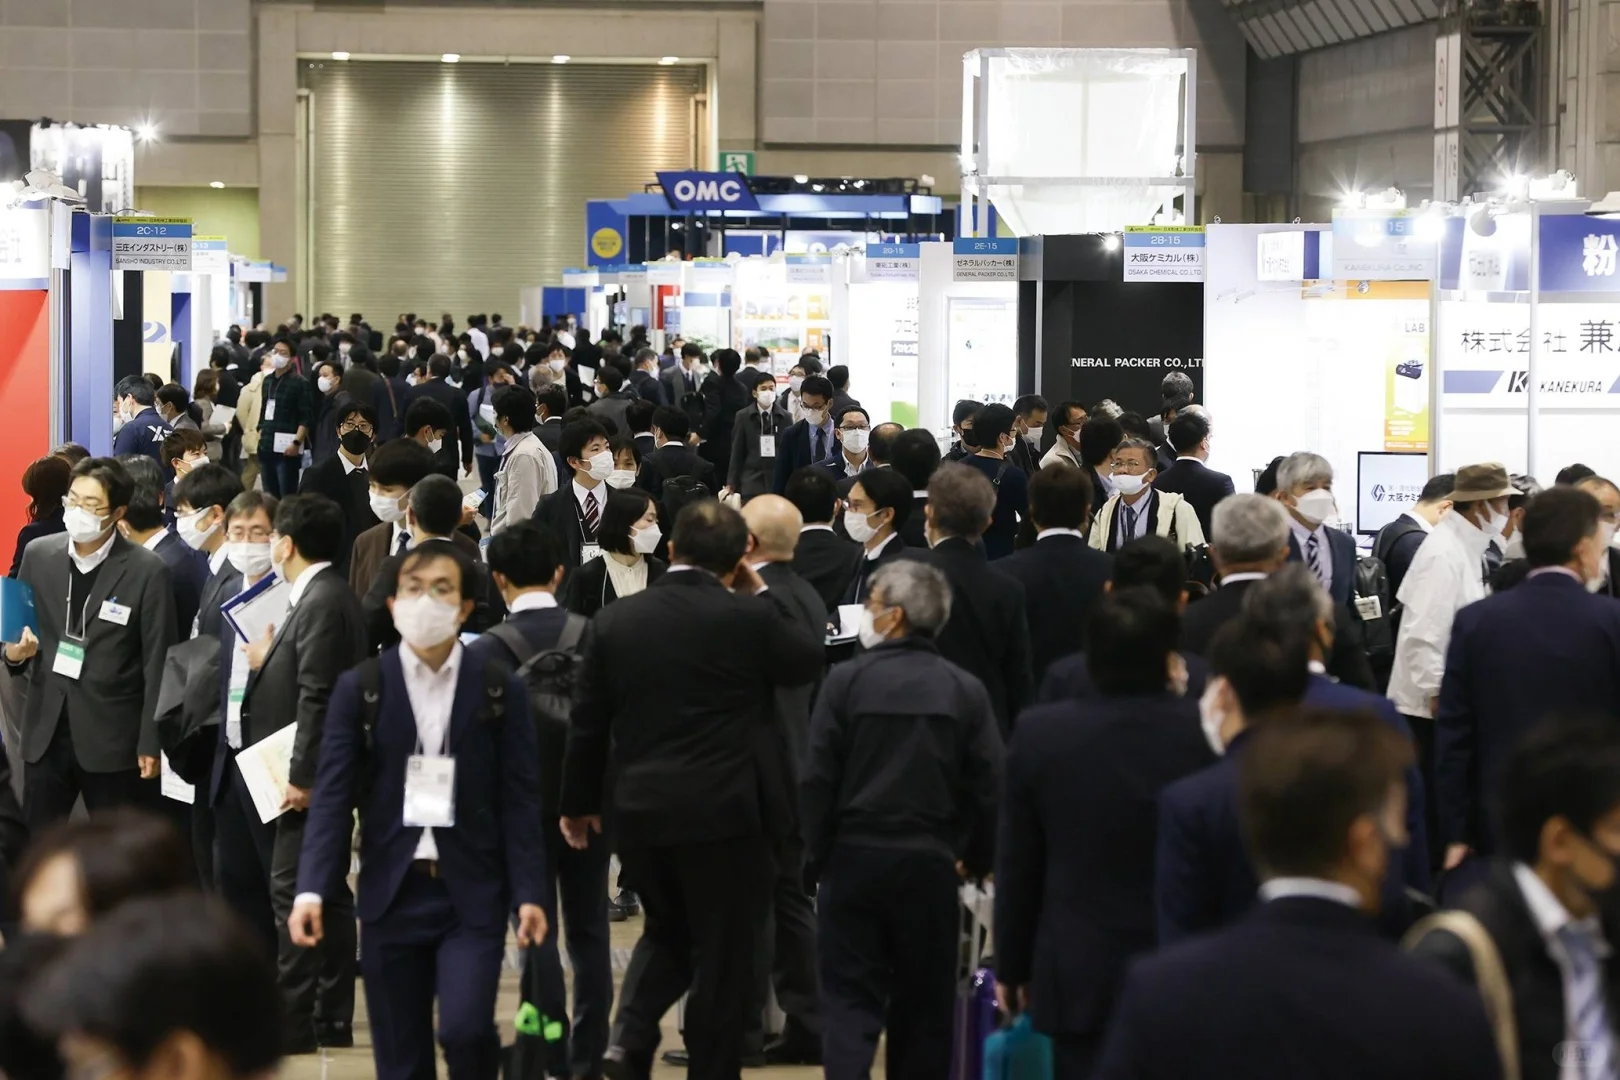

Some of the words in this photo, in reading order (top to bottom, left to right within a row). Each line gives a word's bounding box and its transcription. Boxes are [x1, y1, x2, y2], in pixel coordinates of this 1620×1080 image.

[674, 180, 741, 202] OMC
[136, 226, 167, 235] 2C-12
[1150, 235, 1181, 245] 2B-15
[115, 243, 188, 252] 三庄インダストリー(株)
[974, 242, 998, 250] 2E-15
[1131, 253, 1199, 263] 大阪ケミカル(株)
[1582, 233, 1619, 277] 粉
[1404, 323, 1426, 333] LAB
[1579, 319, 1620, 354] 兼
[1071, 357, 1111, 368] NERAL
[1114, 357, 1161, 368] PACKER
[1163, 357, 1204, 370] CO.,LT
[1539, 380, 1603, 393] KANEKURA
